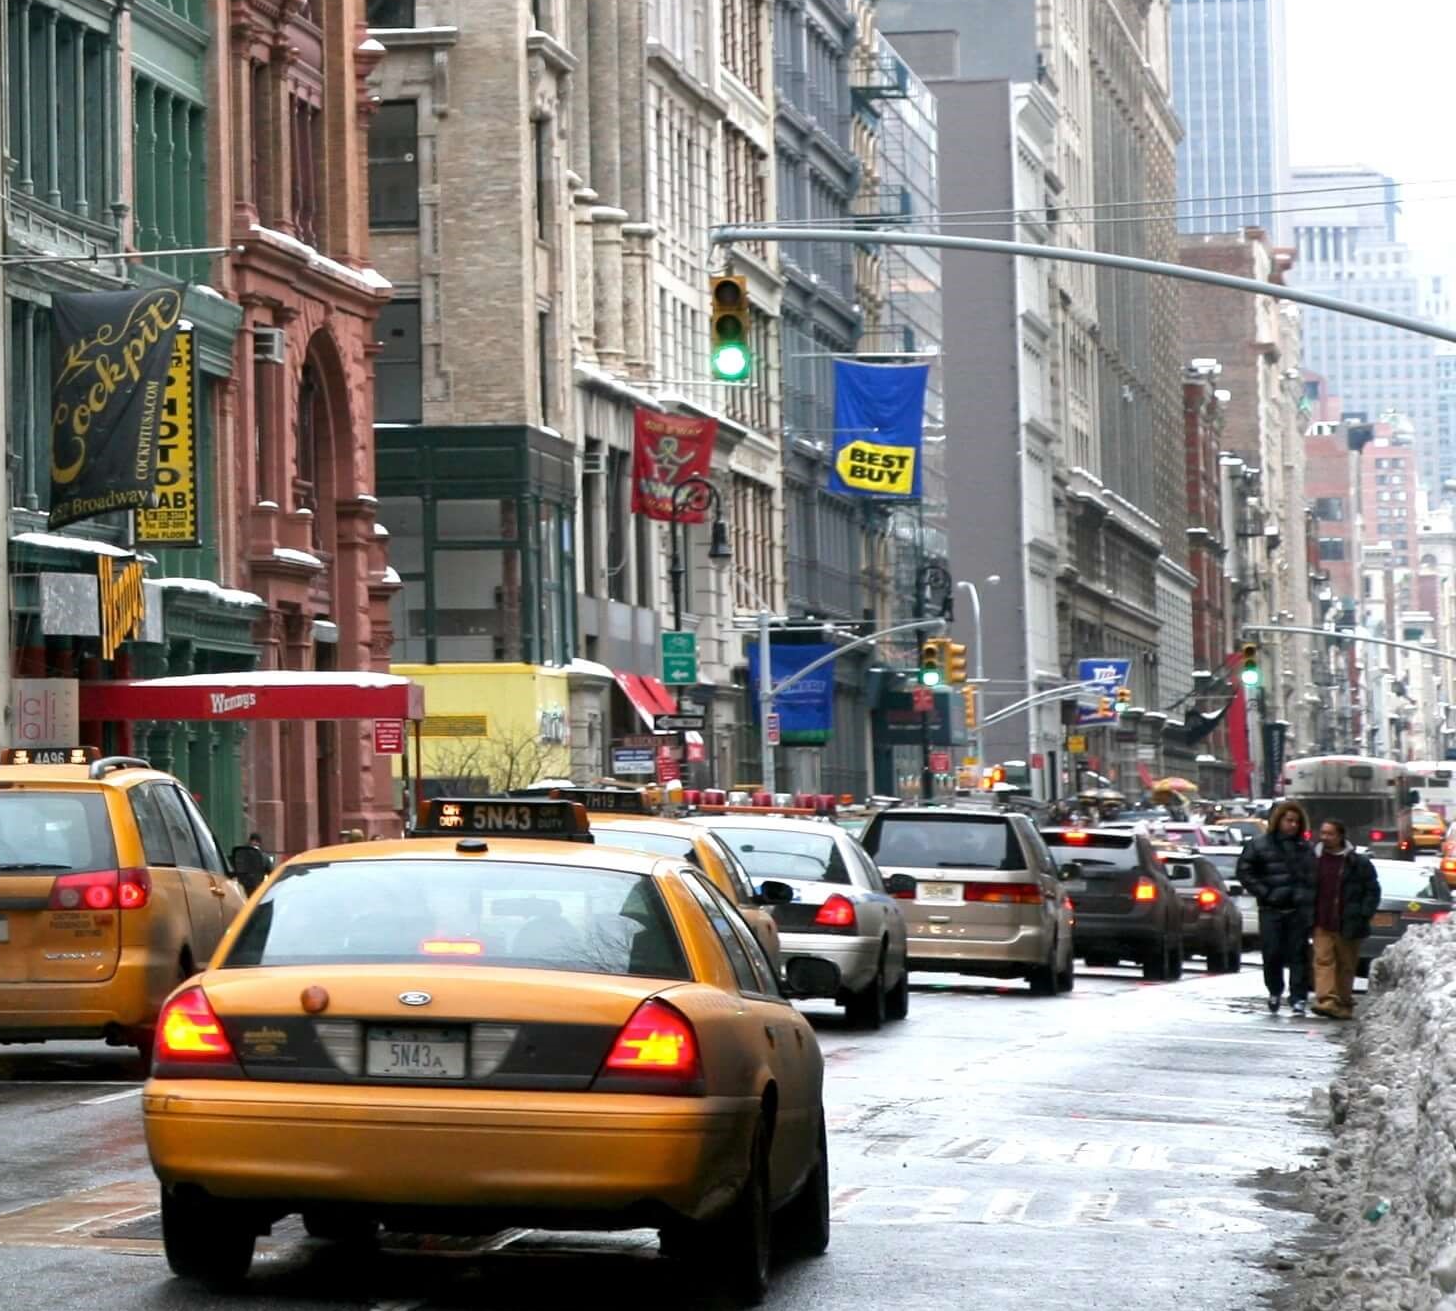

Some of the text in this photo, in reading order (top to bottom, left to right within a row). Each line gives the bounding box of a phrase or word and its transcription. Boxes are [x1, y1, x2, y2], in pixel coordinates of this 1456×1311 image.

[51, 288, 182, 484] Cockpit
[136, 380, 160, 481] COCKPITUSA.COM
[850, 448, 909, 468] BEST
[849, 465, 902, 484] BUY
[72, 489, 148, 515] Broadway
[439, 815, 464, 827] DUTY
[442, 804, 462, 816] OFF
[473, 805, 531, 830] 5N43
